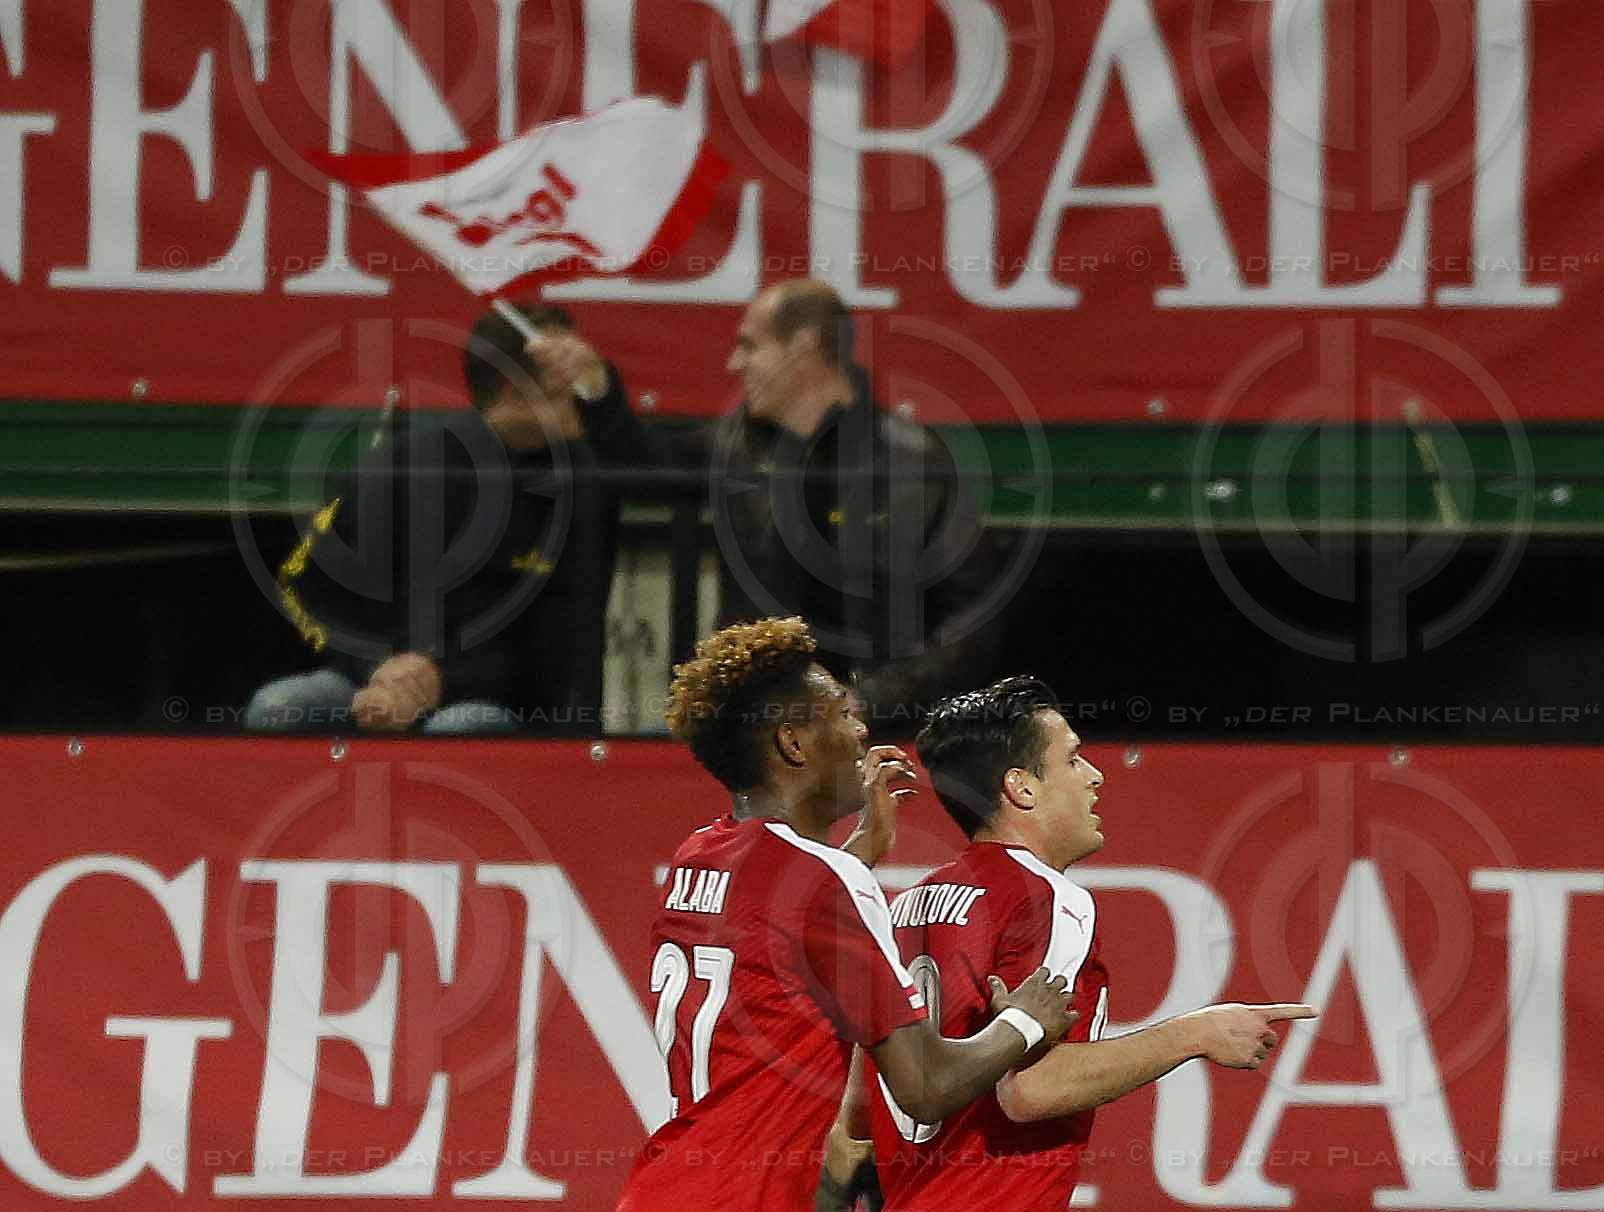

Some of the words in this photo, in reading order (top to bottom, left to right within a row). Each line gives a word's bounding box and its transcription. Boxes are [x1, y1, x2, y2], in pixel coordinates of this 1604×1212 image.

[0, 0, 1562, 309] ENERALI
[665, 867, 731, 914] ALABA
[650, 942, 736, 1104] 27
